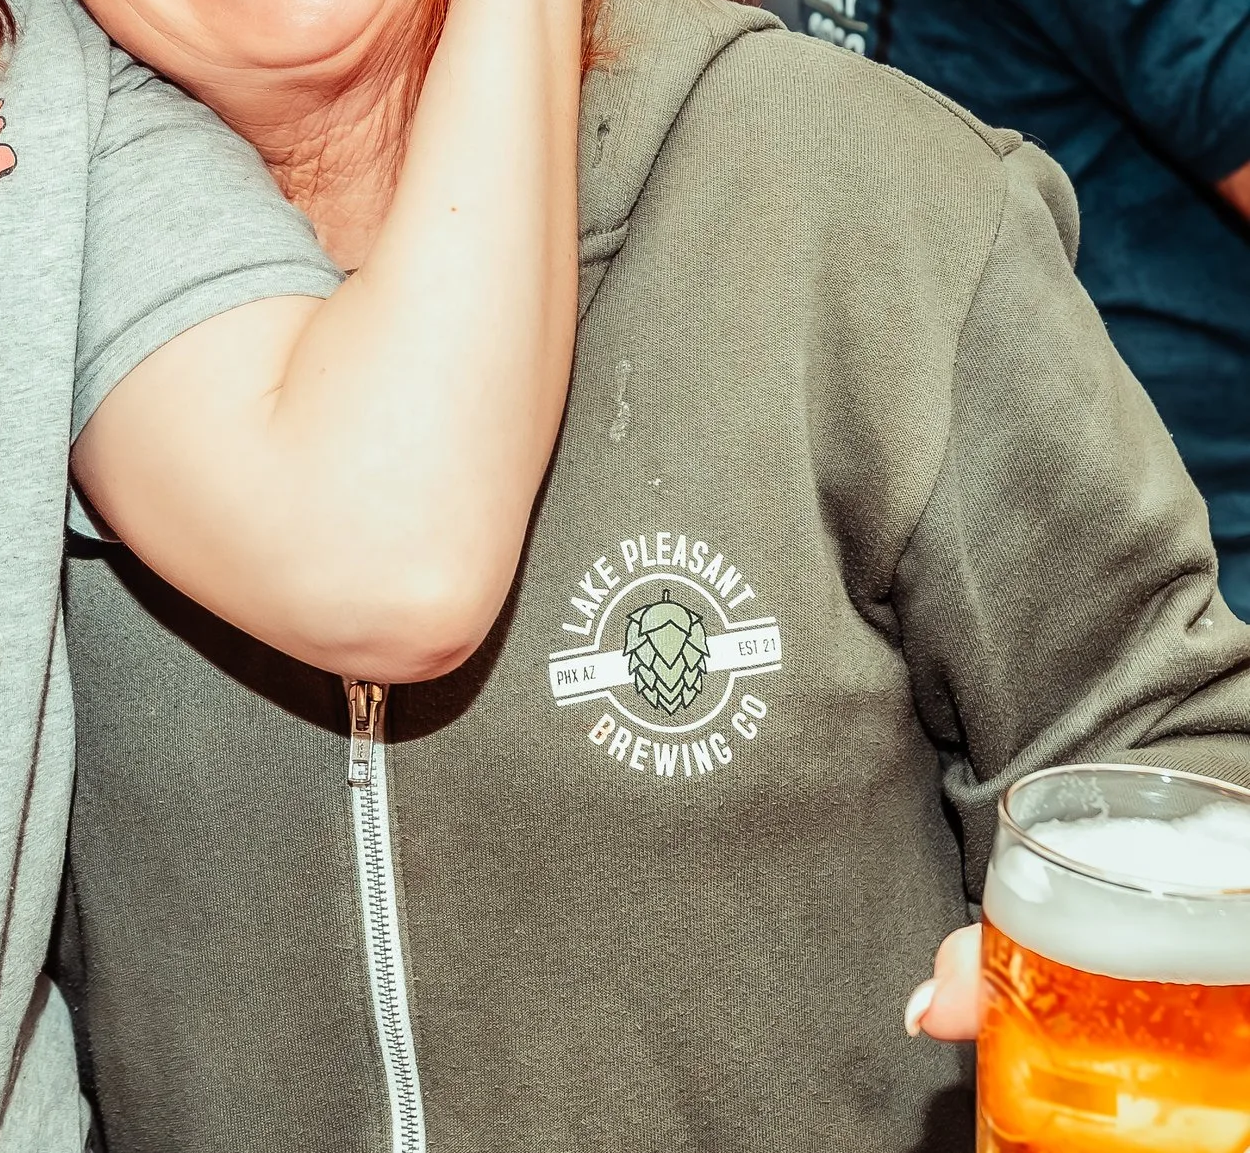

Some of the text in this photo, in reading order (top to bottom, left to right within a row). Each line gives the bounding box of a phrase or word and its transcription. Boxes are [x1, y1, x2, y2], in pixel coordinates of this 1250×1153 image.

[561, 532, 756, 636] LAKE PLEASANT
[738, 638, 776, 656] EST 21
[556, 665, 597, 686] PHX AZ
[588, 694, 767, 778] BREWING CO
